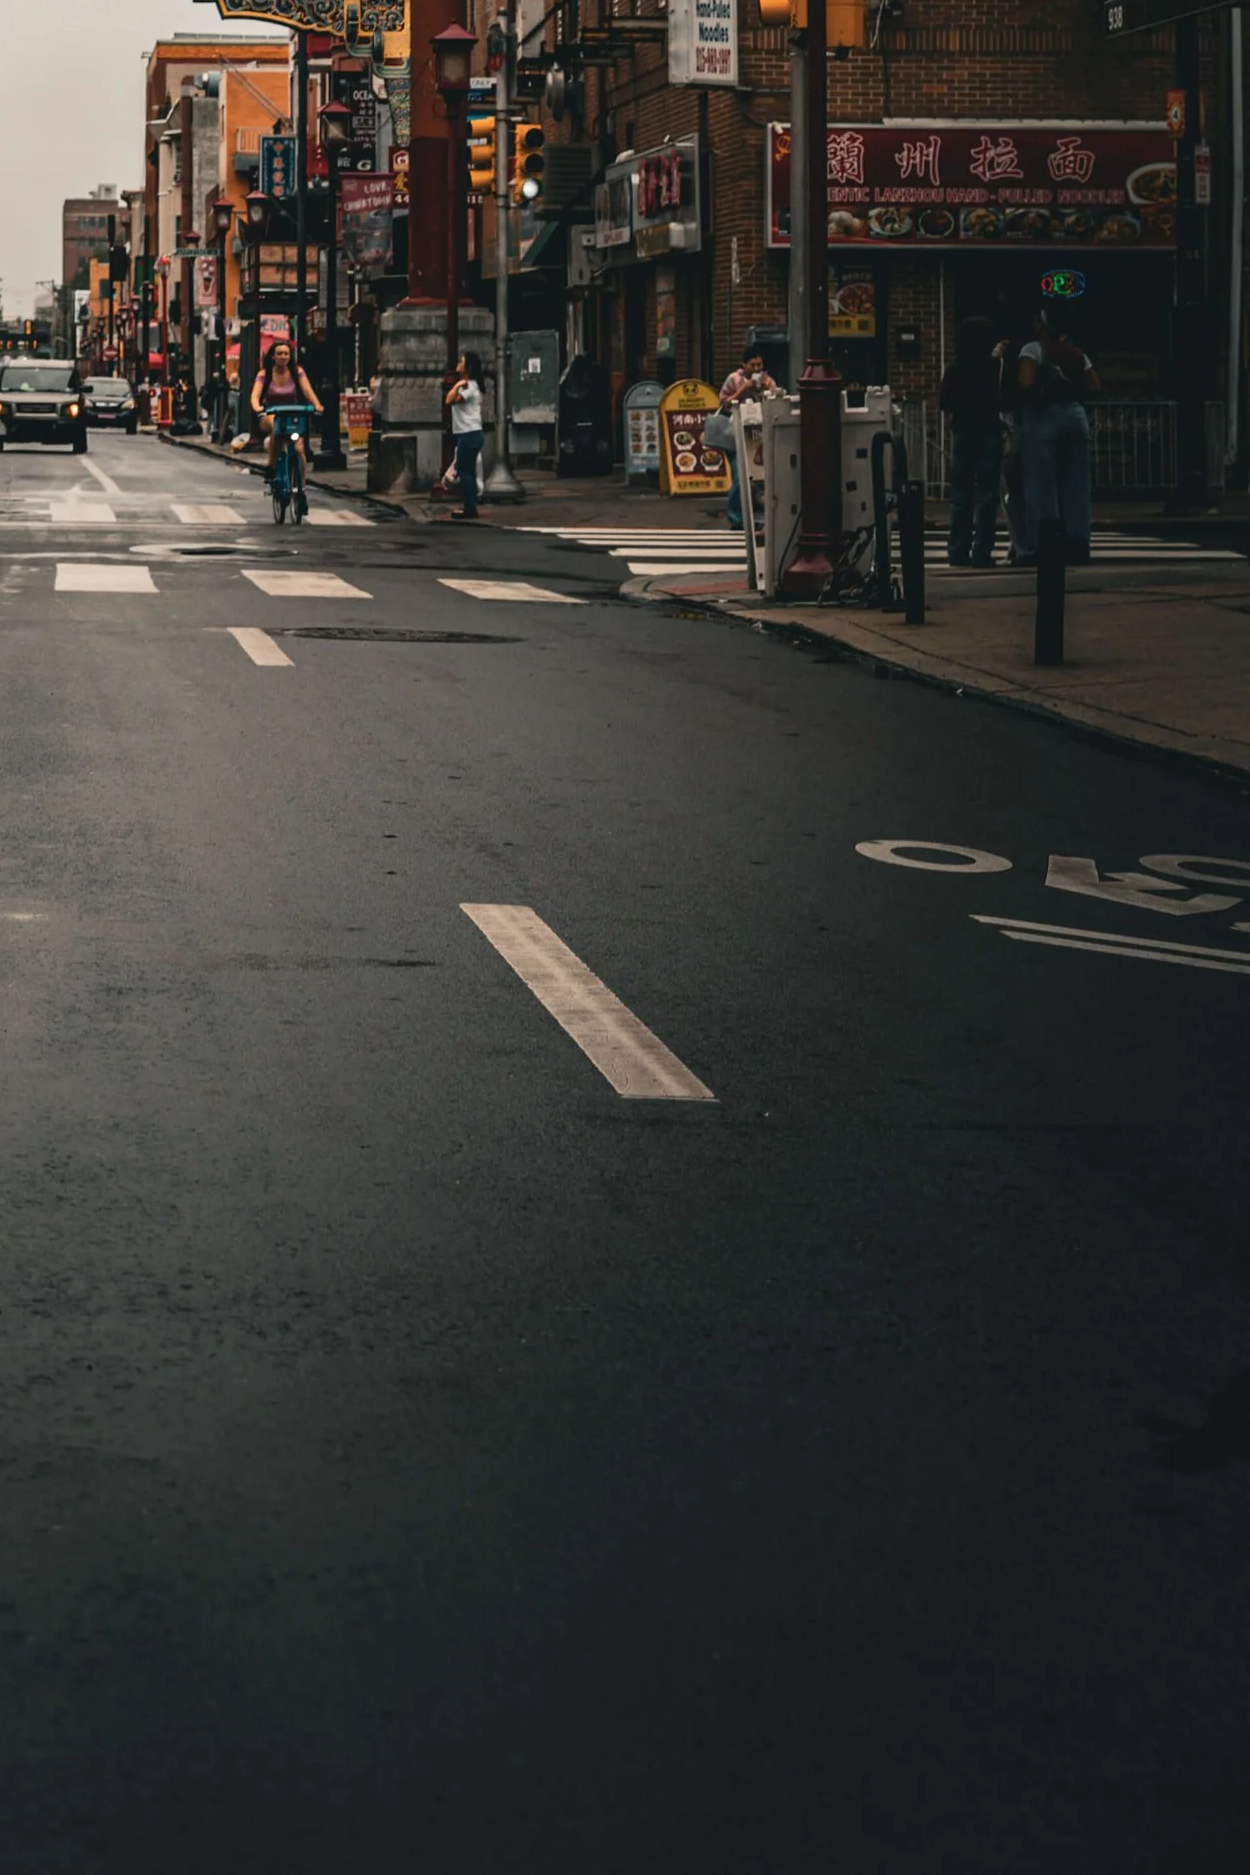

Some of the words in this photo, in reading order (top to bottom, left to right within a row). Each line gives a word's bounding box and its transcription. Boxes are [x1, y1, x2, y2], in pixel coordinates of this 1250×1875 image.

[1108, 6, 1123, 30] 938
[699, 22, 728, 42] Noodles
[875, 187, 944, 203] LANZHOU
